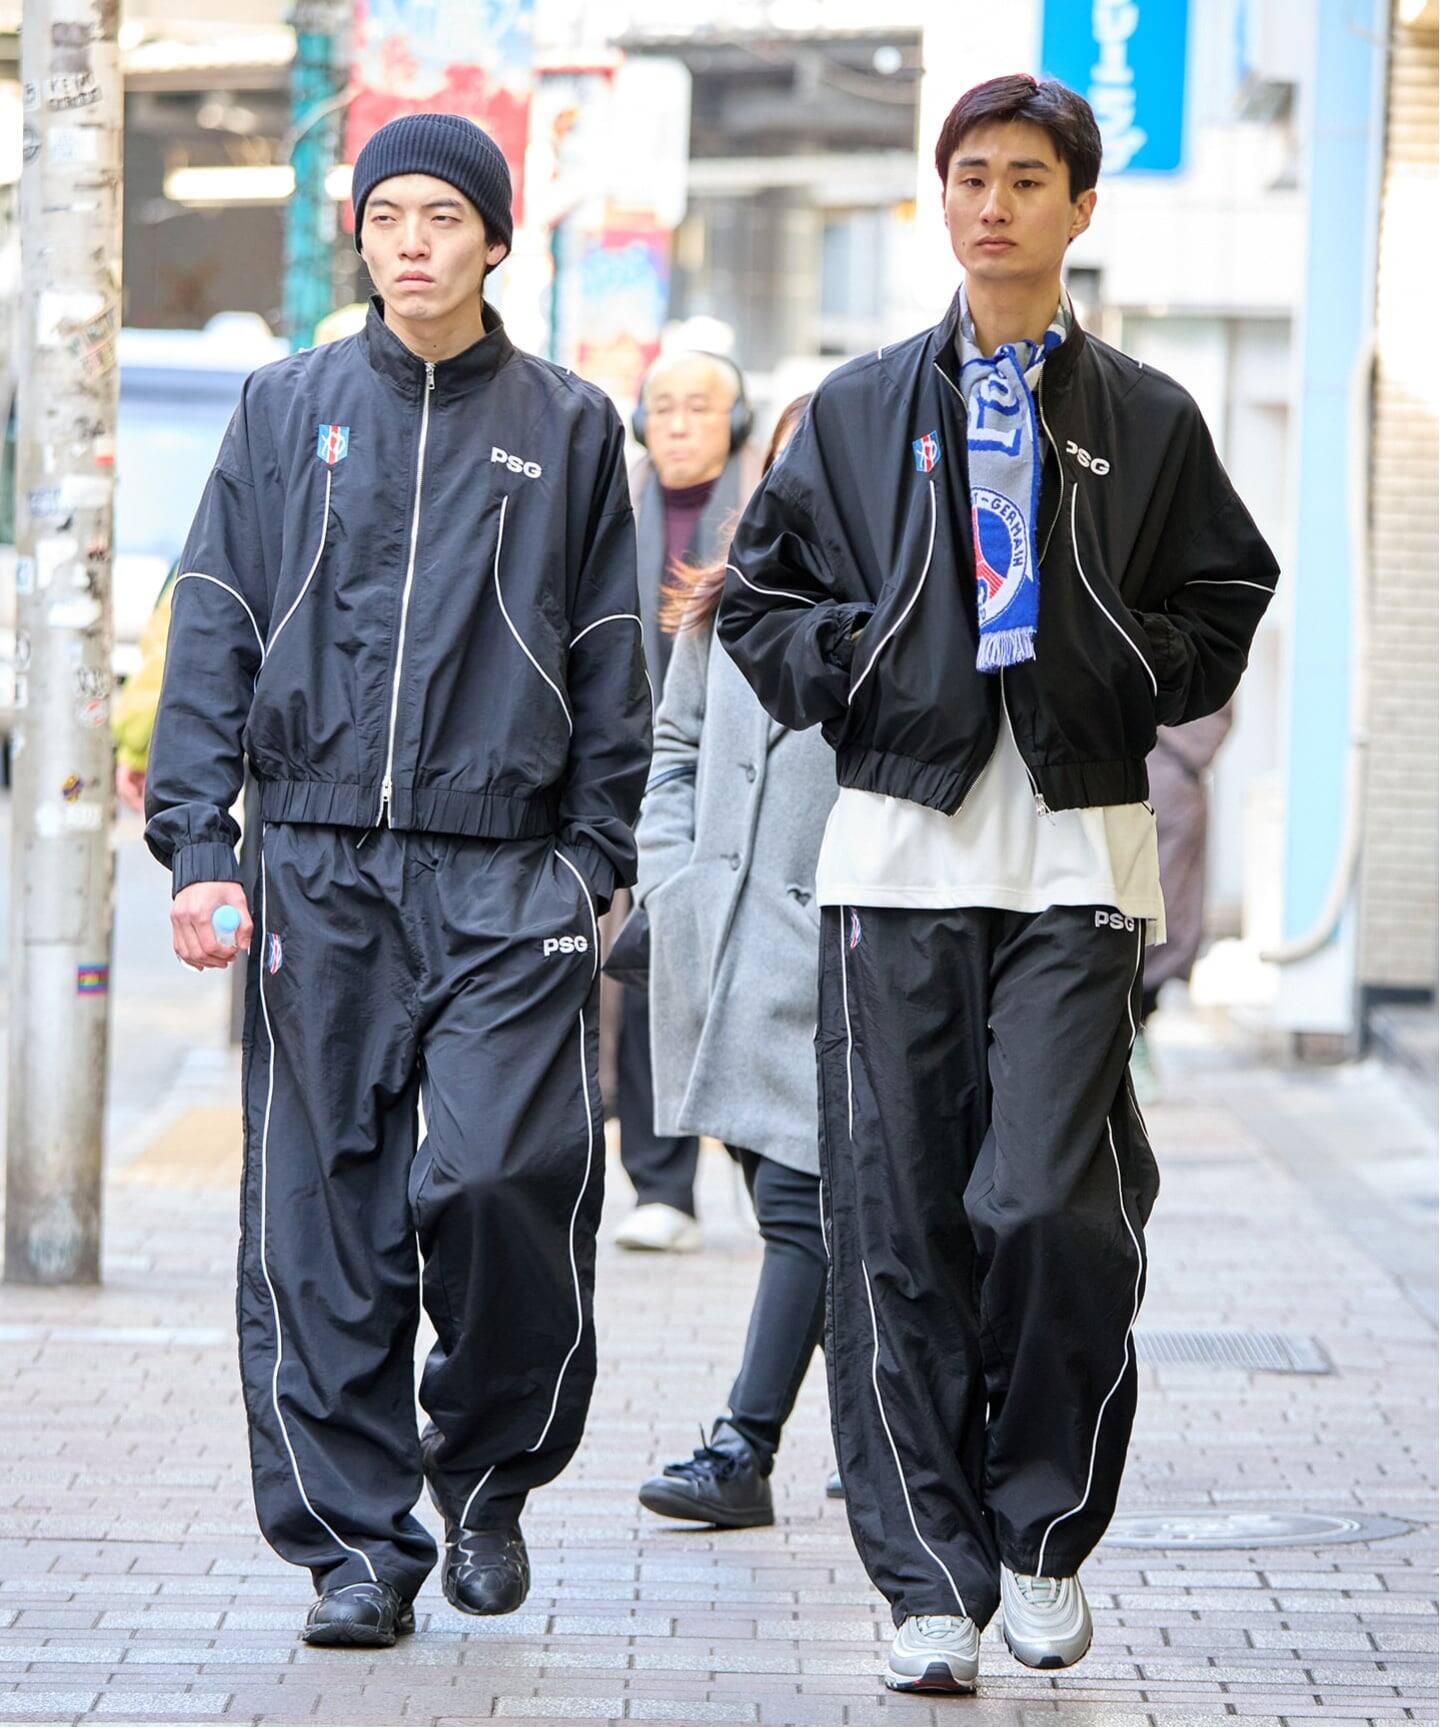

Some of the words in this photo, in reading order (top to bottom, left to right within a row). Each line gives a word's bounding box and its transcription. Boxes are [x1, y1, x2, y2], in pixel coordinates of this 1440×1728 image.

[490, 446, 542, 479] PSG
[1094, 910, 1135, 932] PSG
[543, 935, 588, 957] PSG
